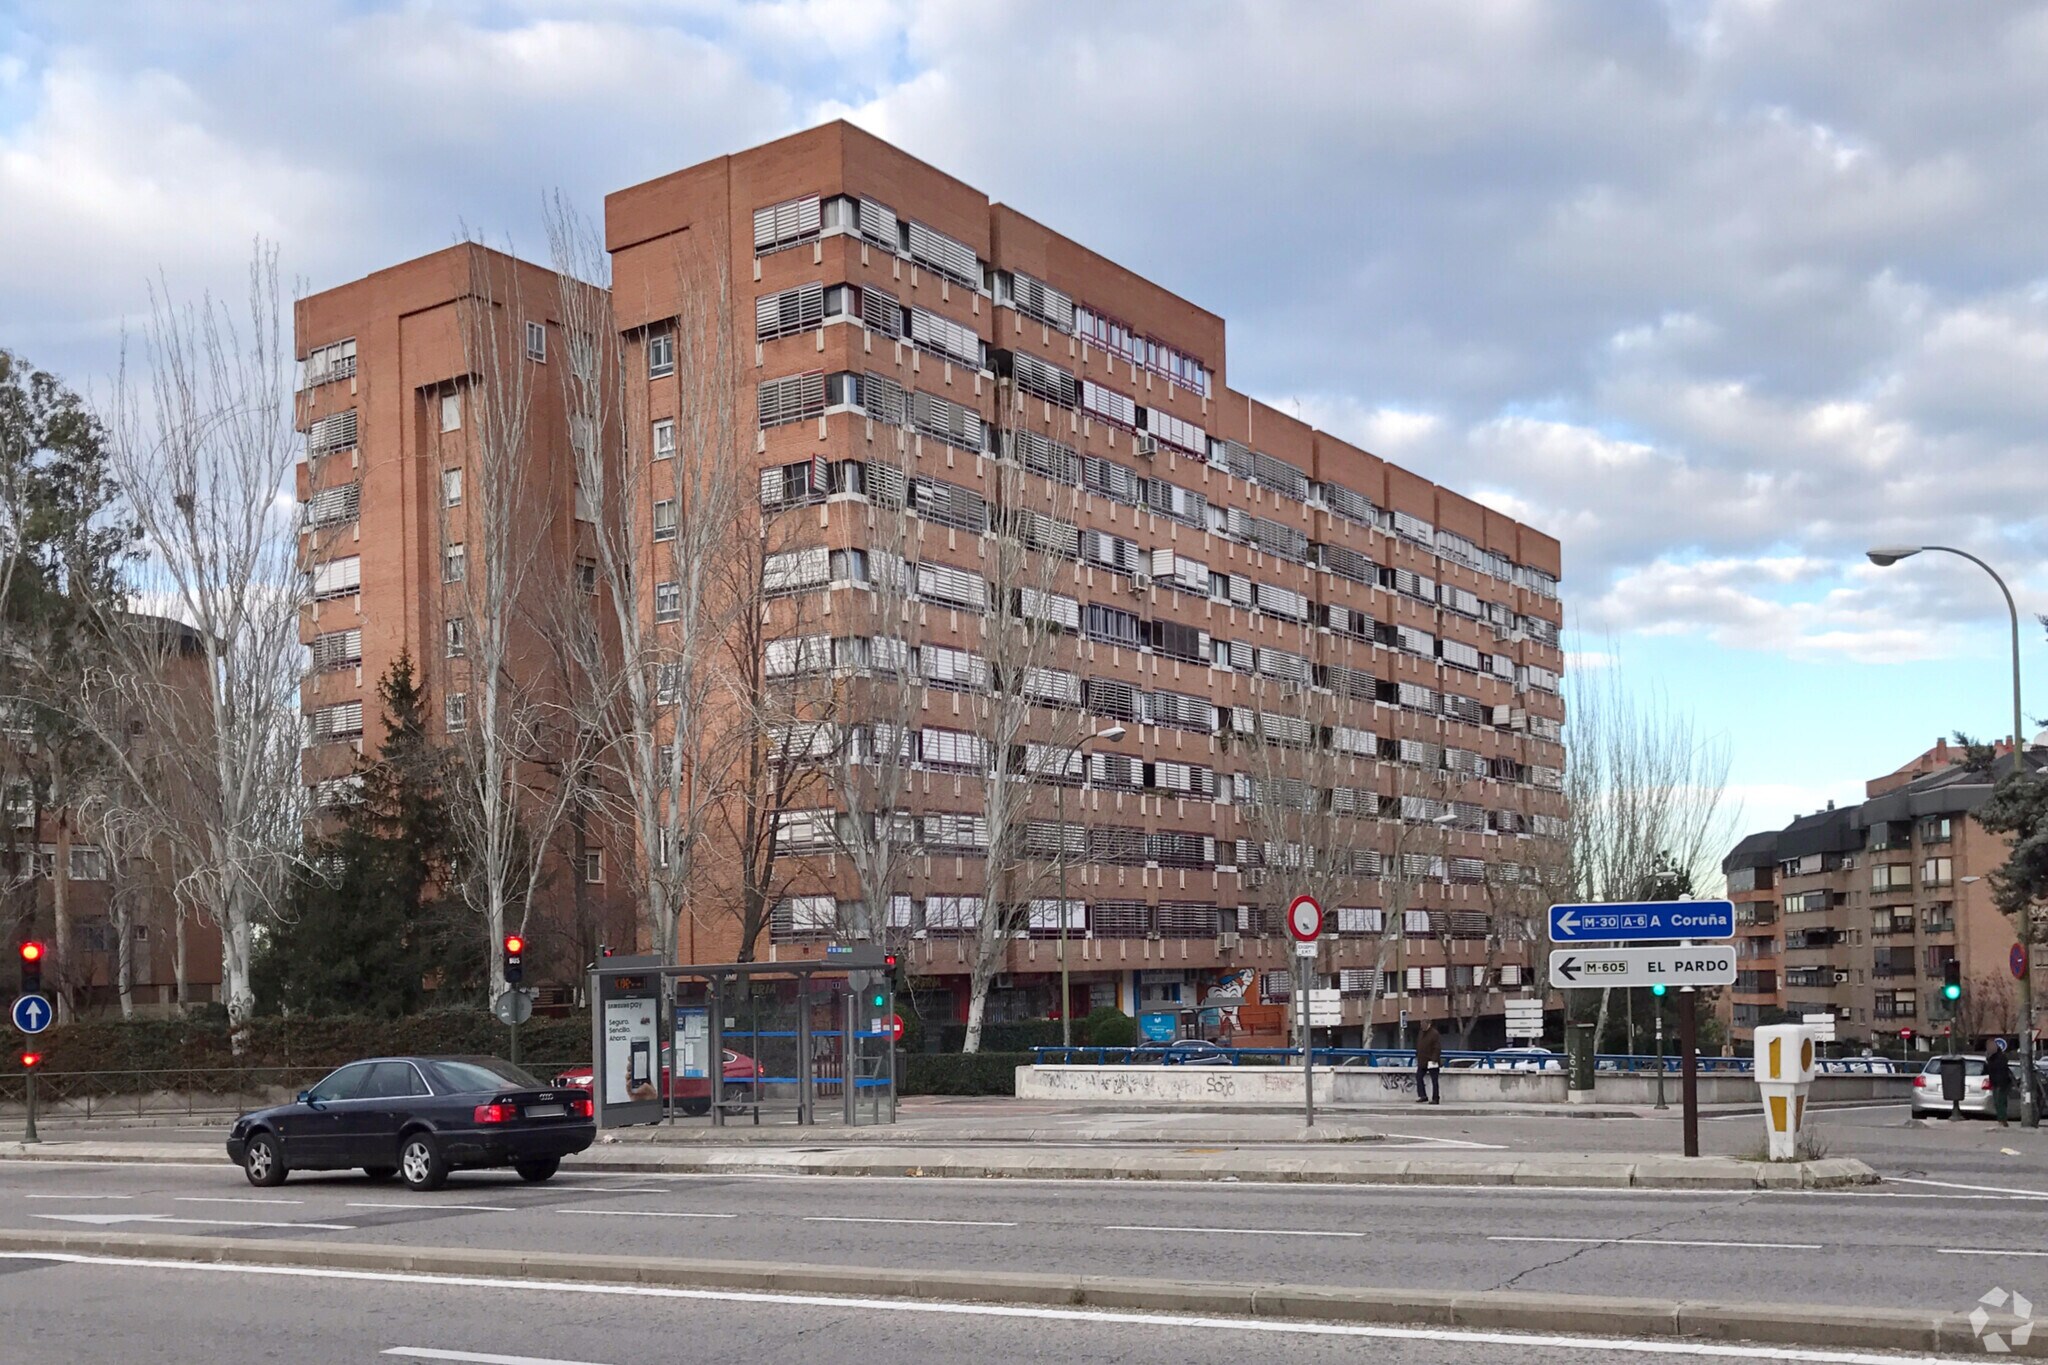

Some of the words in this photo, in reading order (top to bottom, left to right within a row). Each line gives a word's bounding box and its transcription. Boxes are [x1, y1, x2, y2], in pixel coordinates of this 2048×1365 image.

[1584, 917, 1617, 927] M-30
[1623, 916, 1645, 927] A-6
[1650, 916, 1662, 927] A
[1670, 914, 1728, 926] Coruña
[1586, 963, 1626, 972] M-605
[1647, 962, 1666, 973] EL
[1674, 960, 1729, 972] PARDO
